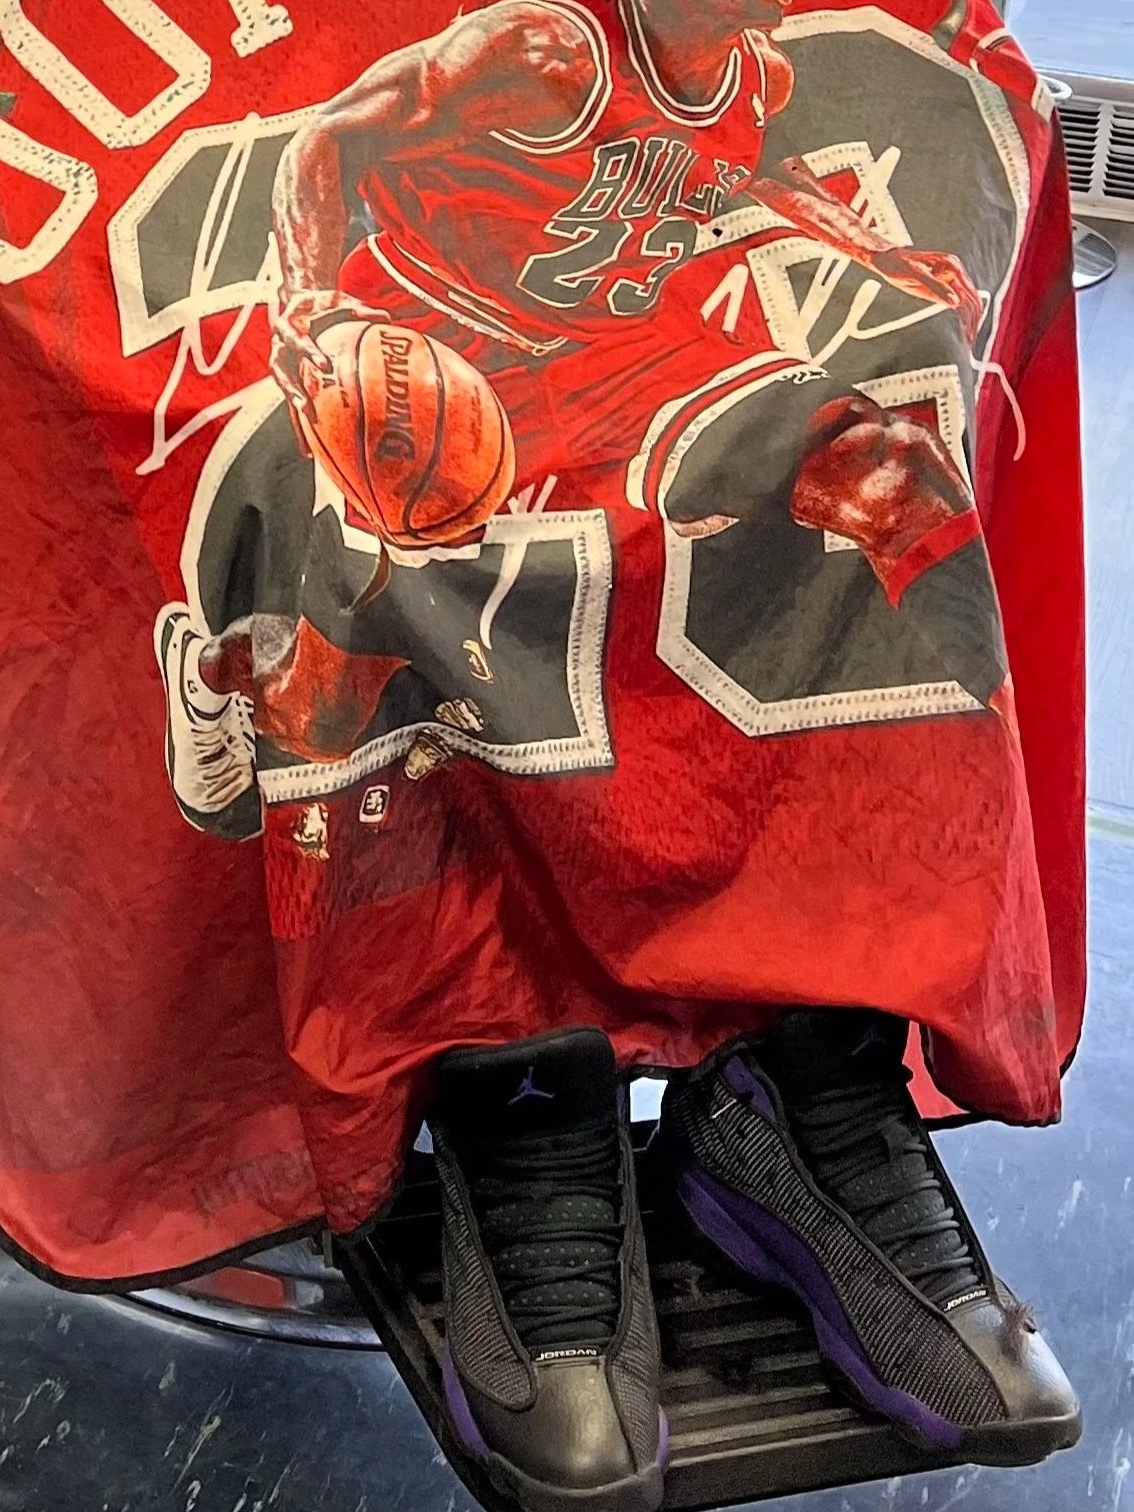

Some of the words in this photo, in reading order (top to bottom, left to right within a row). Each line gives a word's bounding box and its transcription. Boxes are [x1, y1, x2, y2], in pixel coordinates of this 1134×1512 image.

[516, 215, 703, 316] 23
[375, 329, 416, 463] SPALDING
[943, 1289, 987, 1312] JORDAN
[535, 1348, 597, 1362] JORDAN
